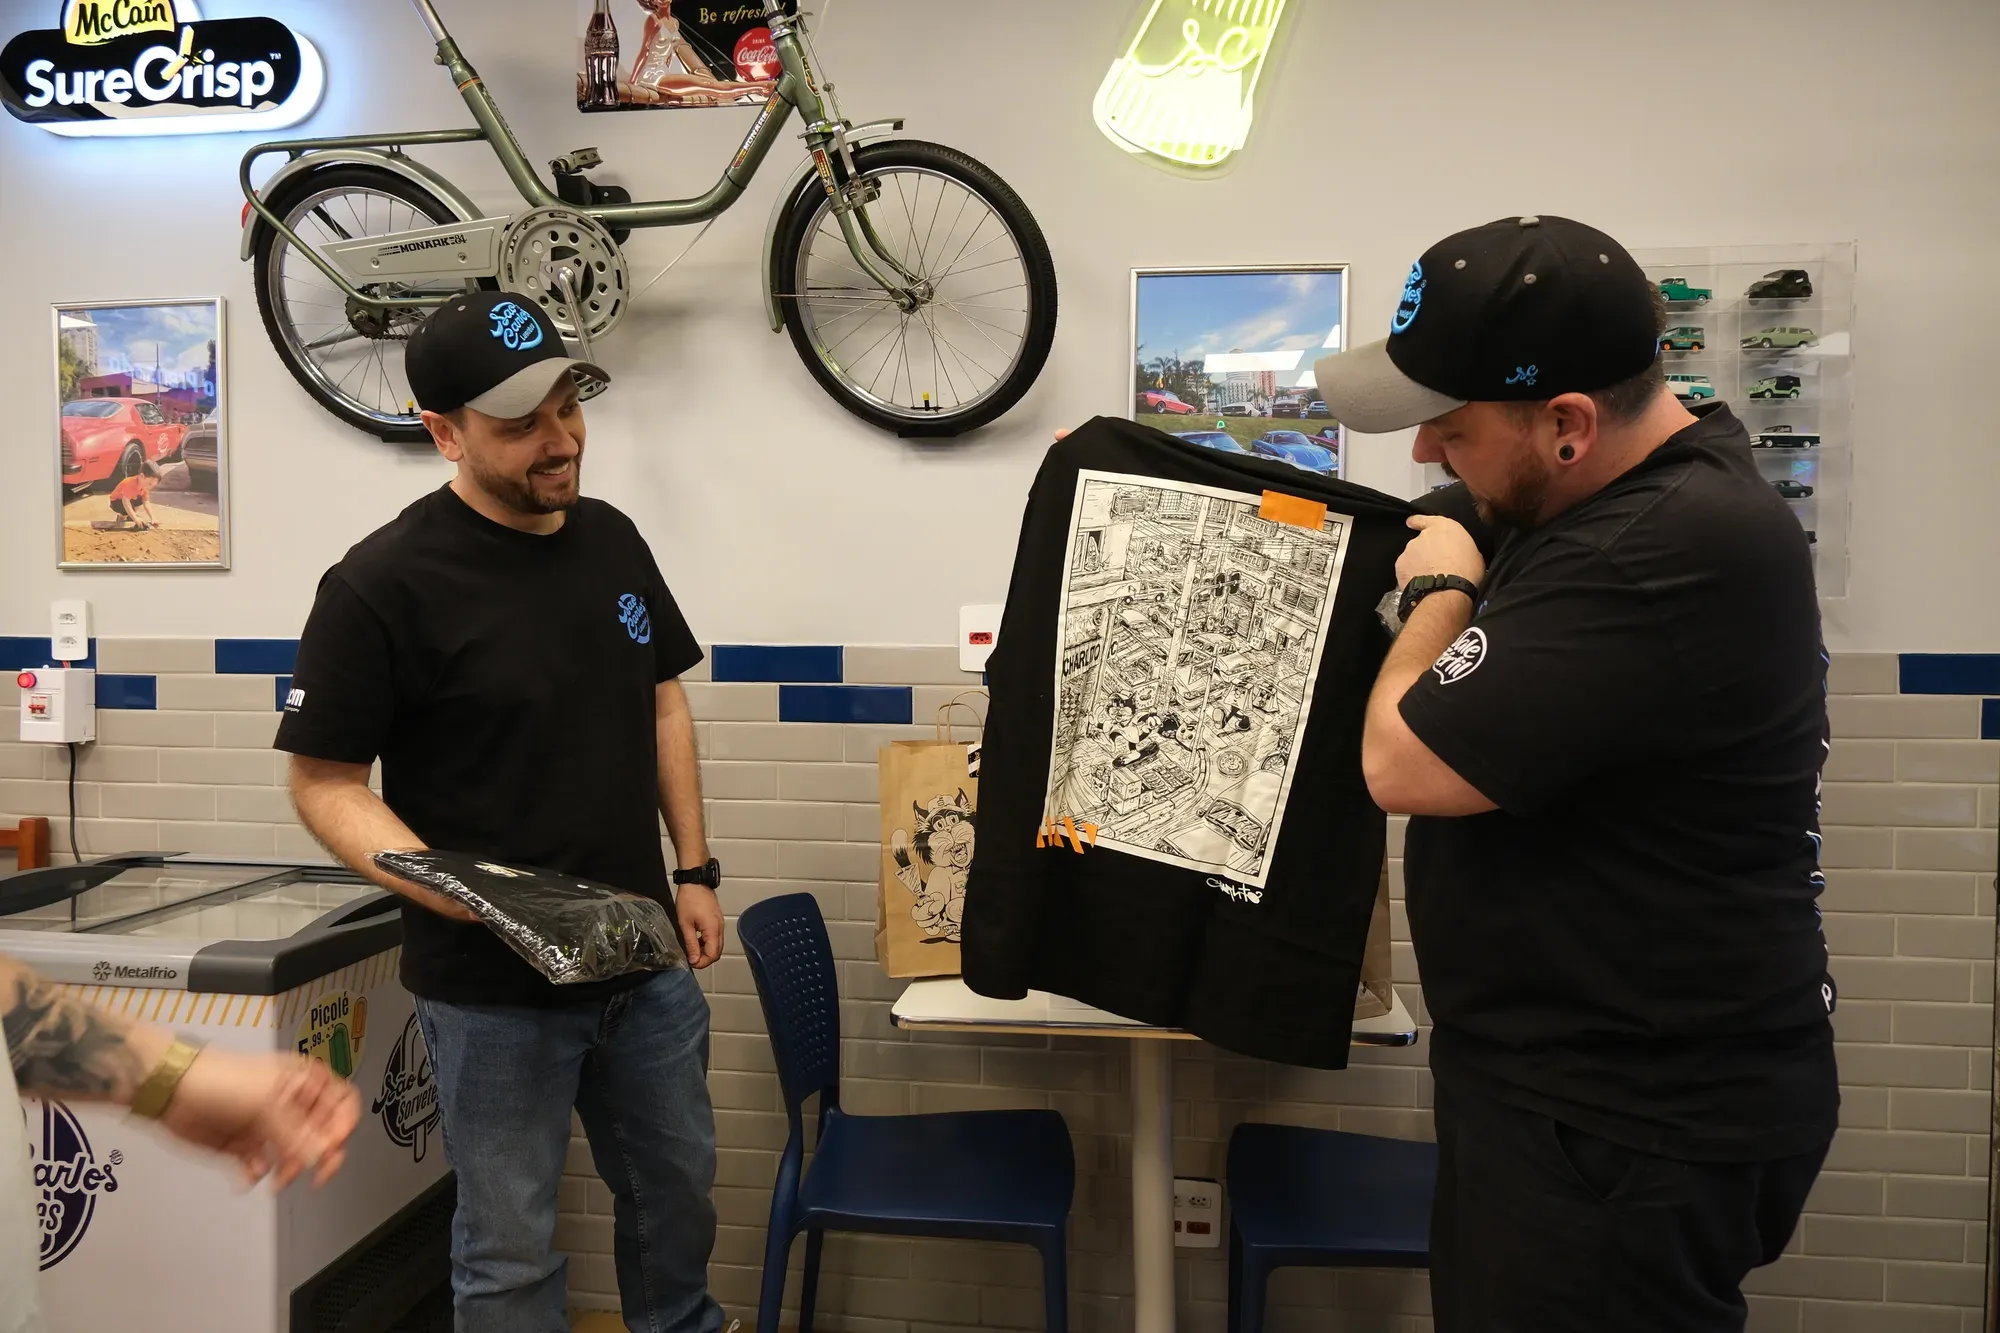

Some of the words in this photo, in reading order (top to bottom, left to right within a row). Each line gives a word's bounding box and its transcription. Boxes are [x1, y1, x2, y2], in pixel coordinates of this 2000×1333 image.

[75, 0, 169, 37] McCain
[699, 8, 717, 24] Be
[24, 46, 276, 108] SureCrisp
[743, 110, 769, 150] MONARK
[399, 237, 450, 253] MONARK
[114, 965, 178, 979] Metalfrio
[310, 990, 350, 1031] Picolé
[398, 1083, 439, 1124] Sorvete
